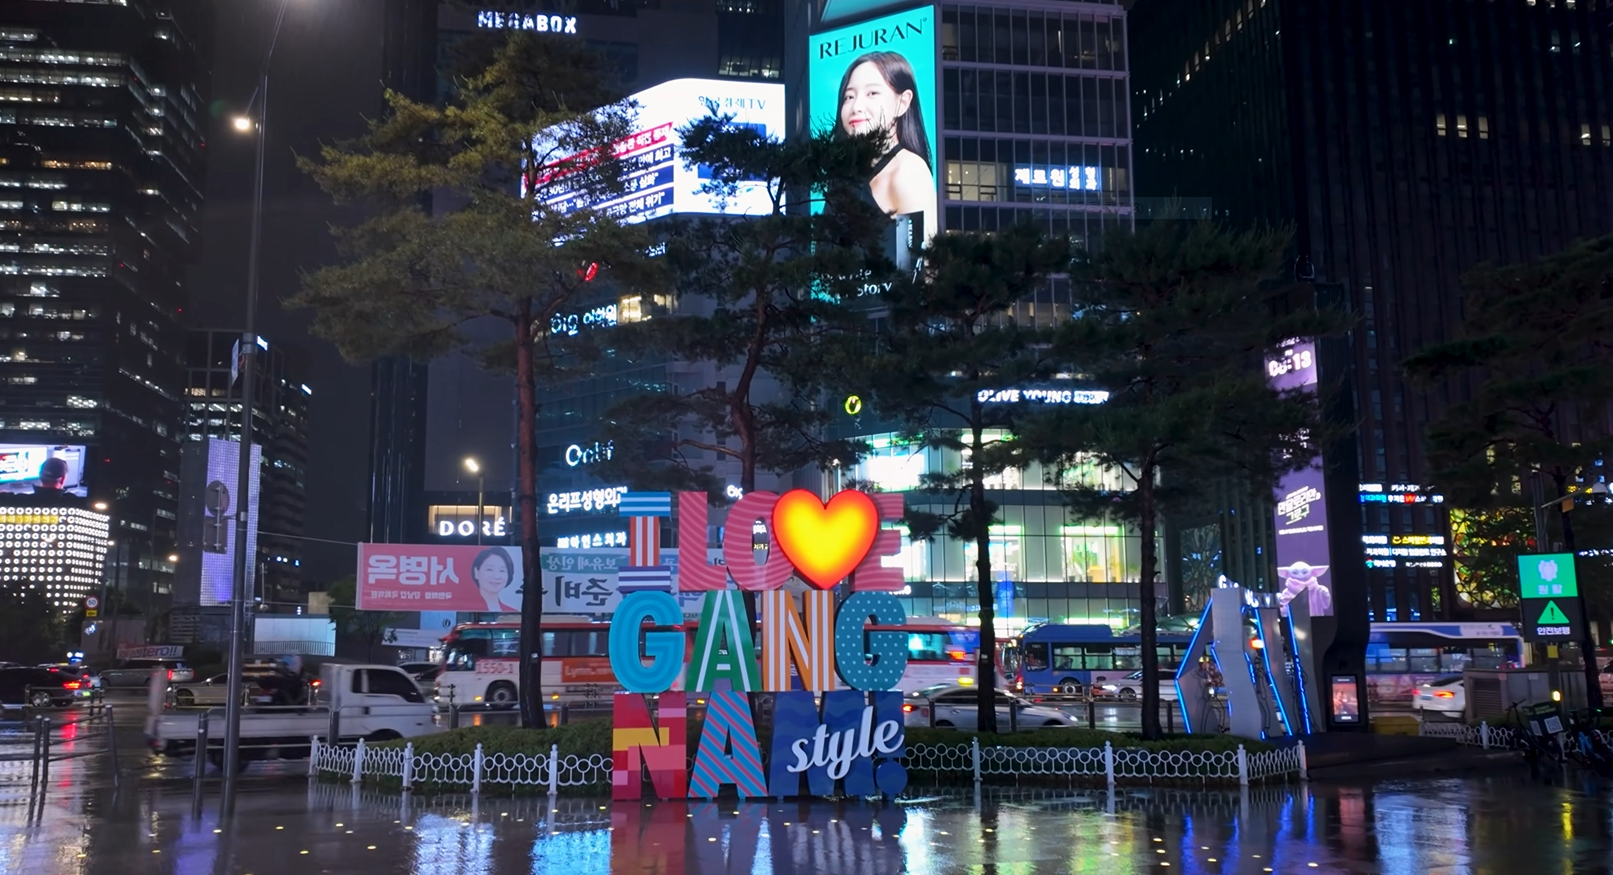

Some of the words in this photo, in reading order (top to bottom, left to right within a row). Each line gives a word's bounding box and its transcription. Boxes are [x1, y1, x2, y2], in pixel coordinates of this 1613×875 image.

[477, 11, 577, 34] MEGABOX
[820, 18, 923, 59] REJURAN
[977, 389, 1020, 402] OLIVE
[1023, 390, 1072, 404] YOUNG
[439, 516, 506, 537] DORÉ
[608, 590, 909, 693] GANG
[1536, 626, 1571, 636] 안전보행
[475, 661, 514, 675] 1550-1
[786, 705, 905, 781] style
